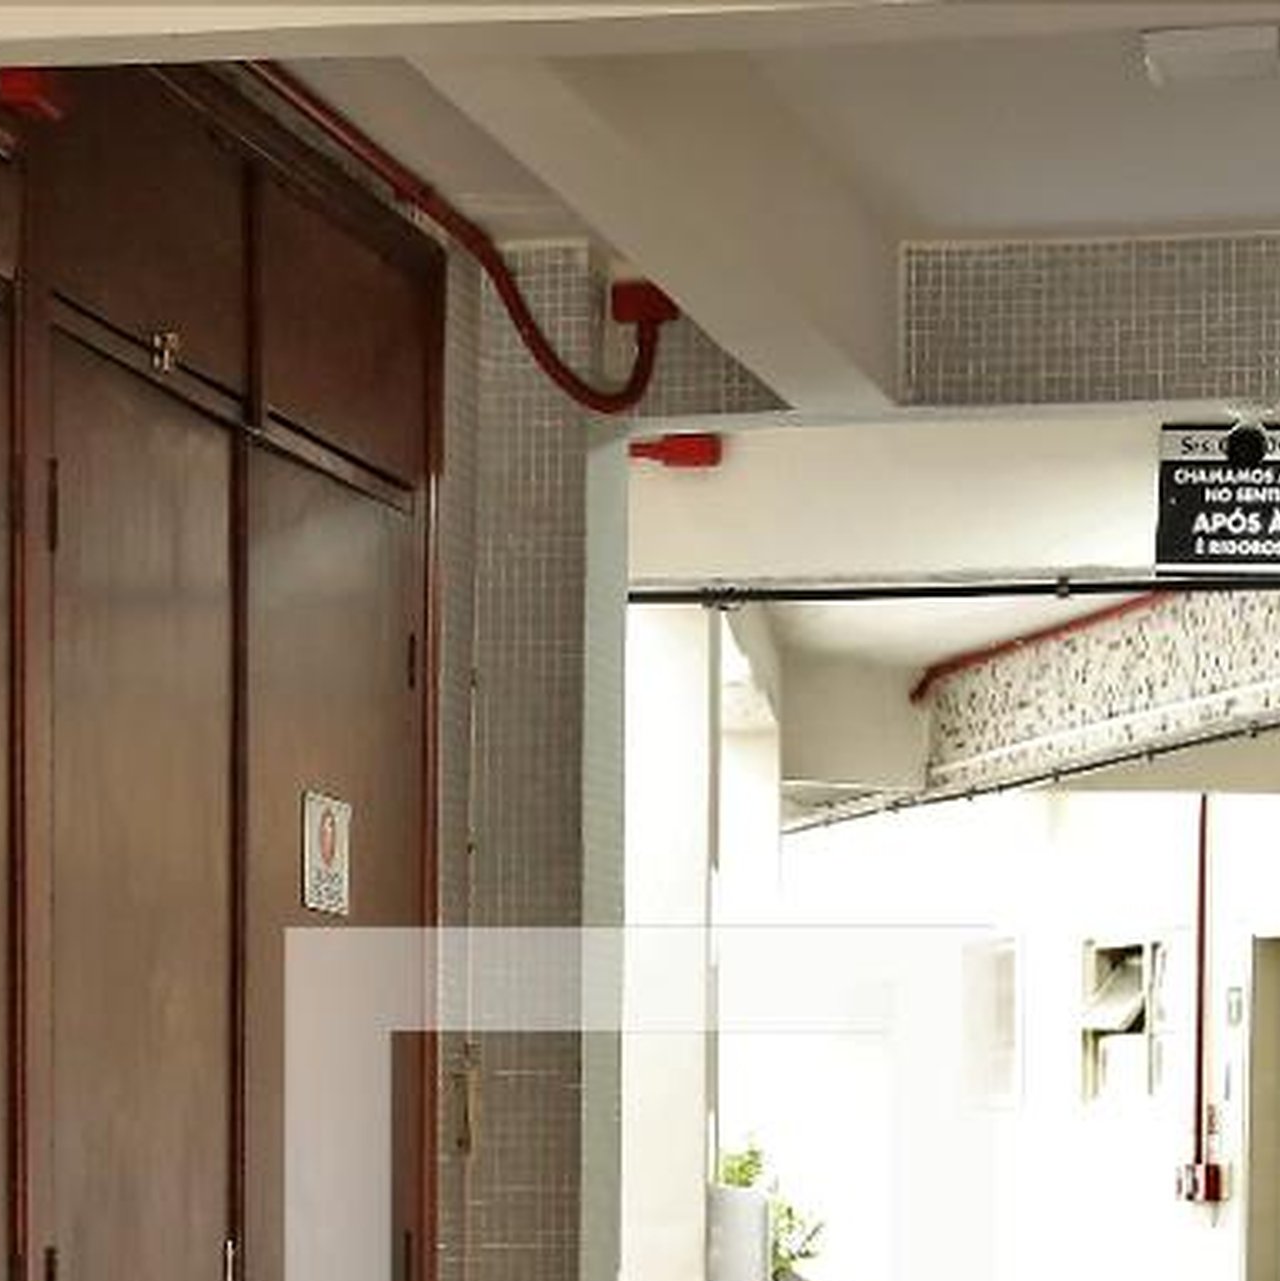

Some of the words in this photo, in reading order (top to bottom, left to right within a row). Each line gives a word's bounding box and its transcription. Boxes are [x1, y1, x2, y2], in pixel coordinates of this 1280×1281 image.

[1174, 468, 1274, 484] CHAMAMOS
[1205, 487, 1233, 502] NO
[1193, 507, 1262, 534] APÓS
[1195, 536, 1205, 554] É
